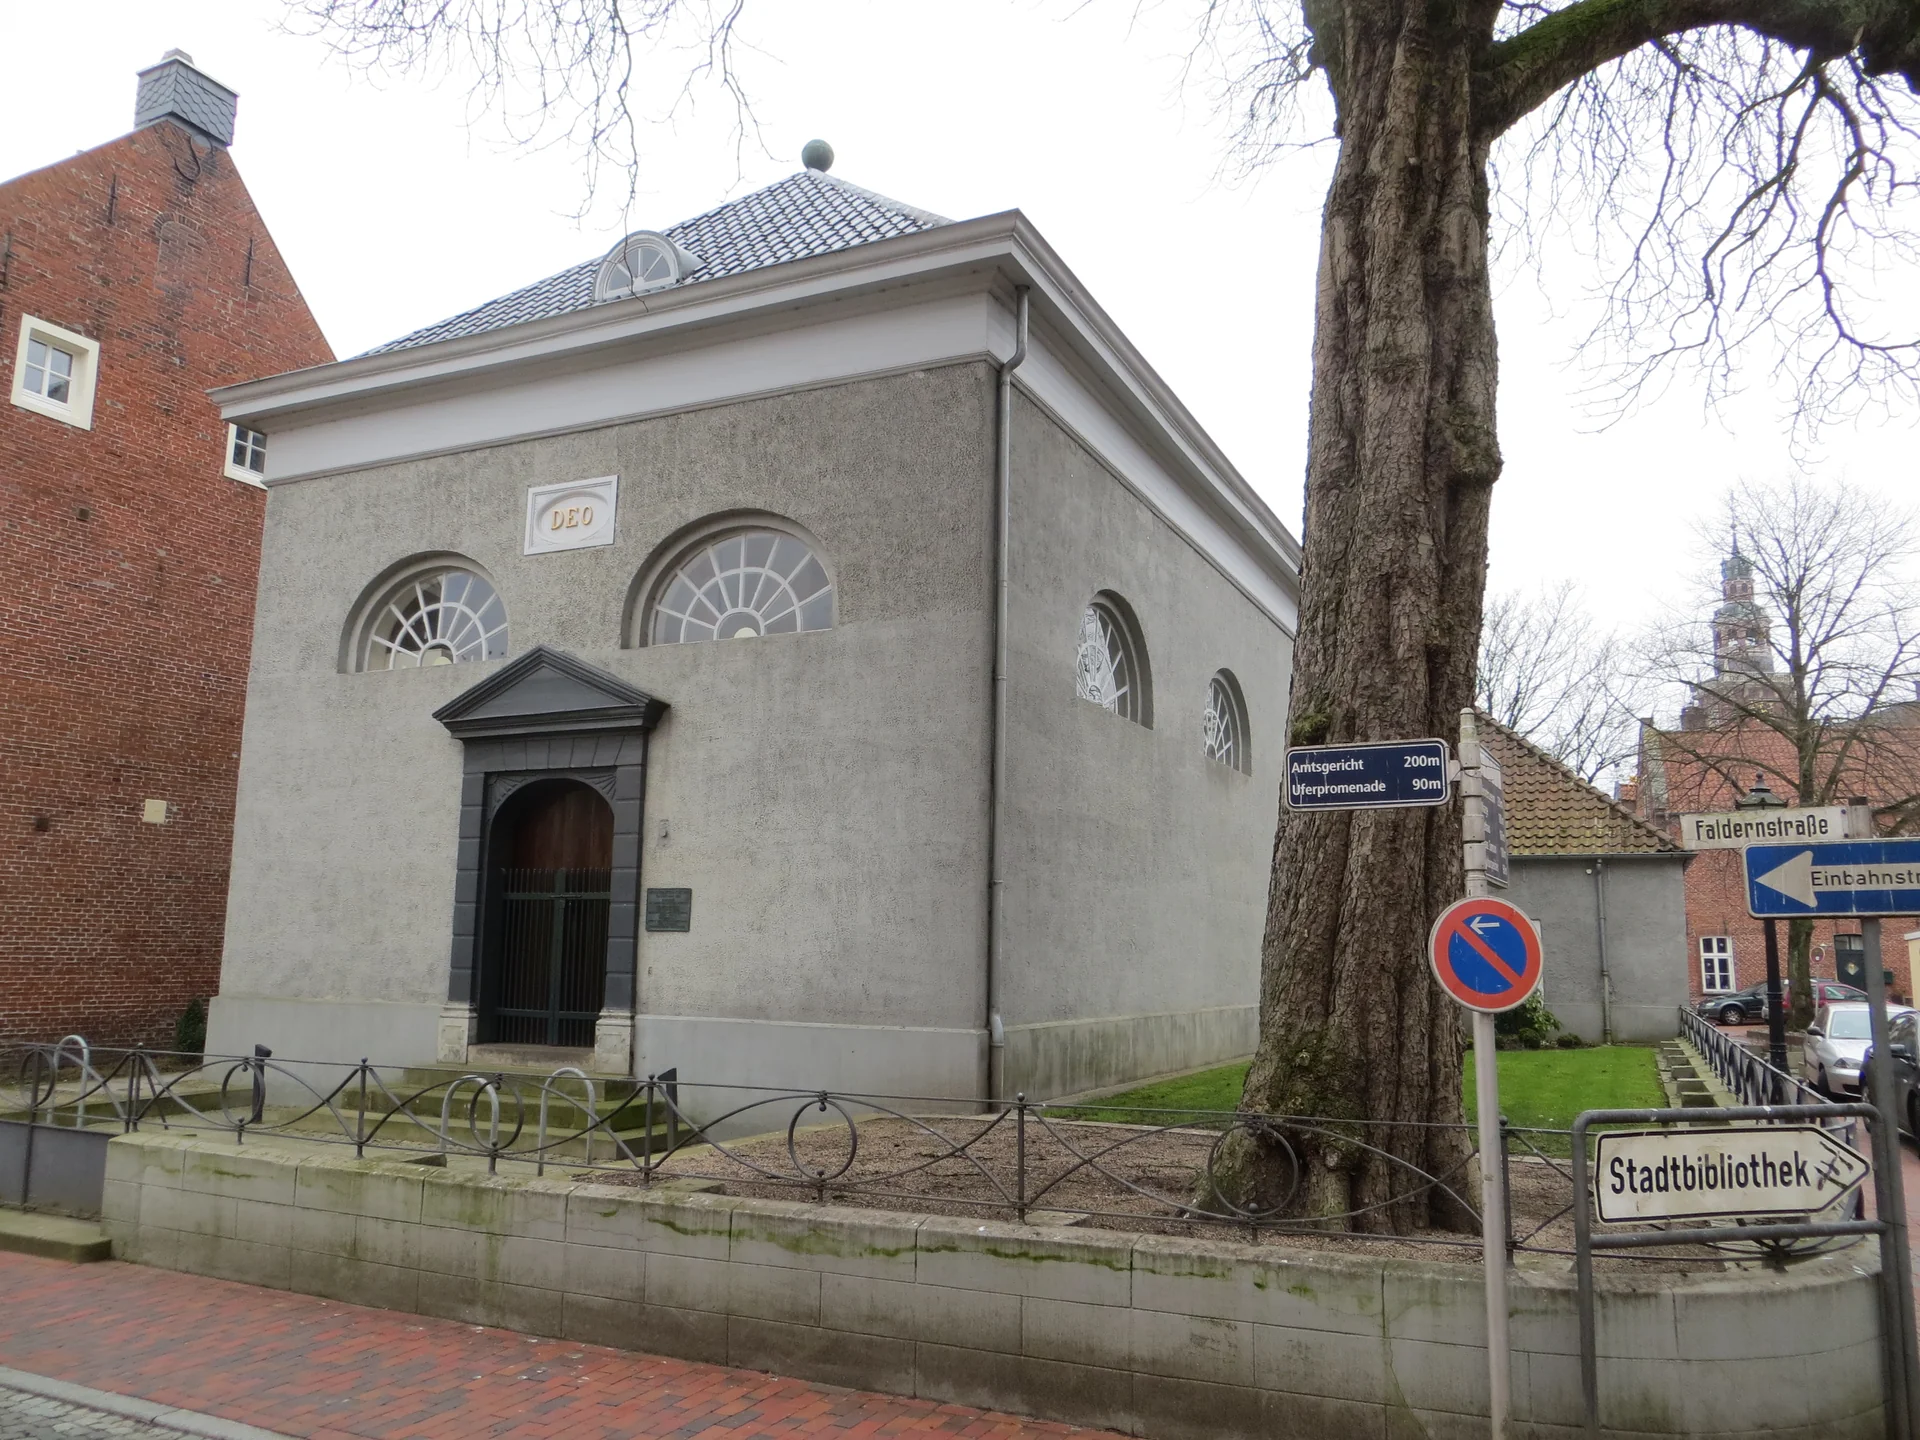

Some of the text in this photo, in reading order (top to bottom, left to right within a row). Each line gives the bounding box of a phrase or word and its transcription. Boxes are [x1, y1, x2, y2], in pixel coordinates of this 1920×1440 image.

[550, 505, 594, 531] DEO
[1291, 756, 1440, 775] Amtsgericht 200m
[1292, 778, 1441, 797] Uferpromenade 90m
[1695, 814, 1829, 841] Faldernstraße
[1609, 1150, 1811, 1195] Stadtbibliothek
